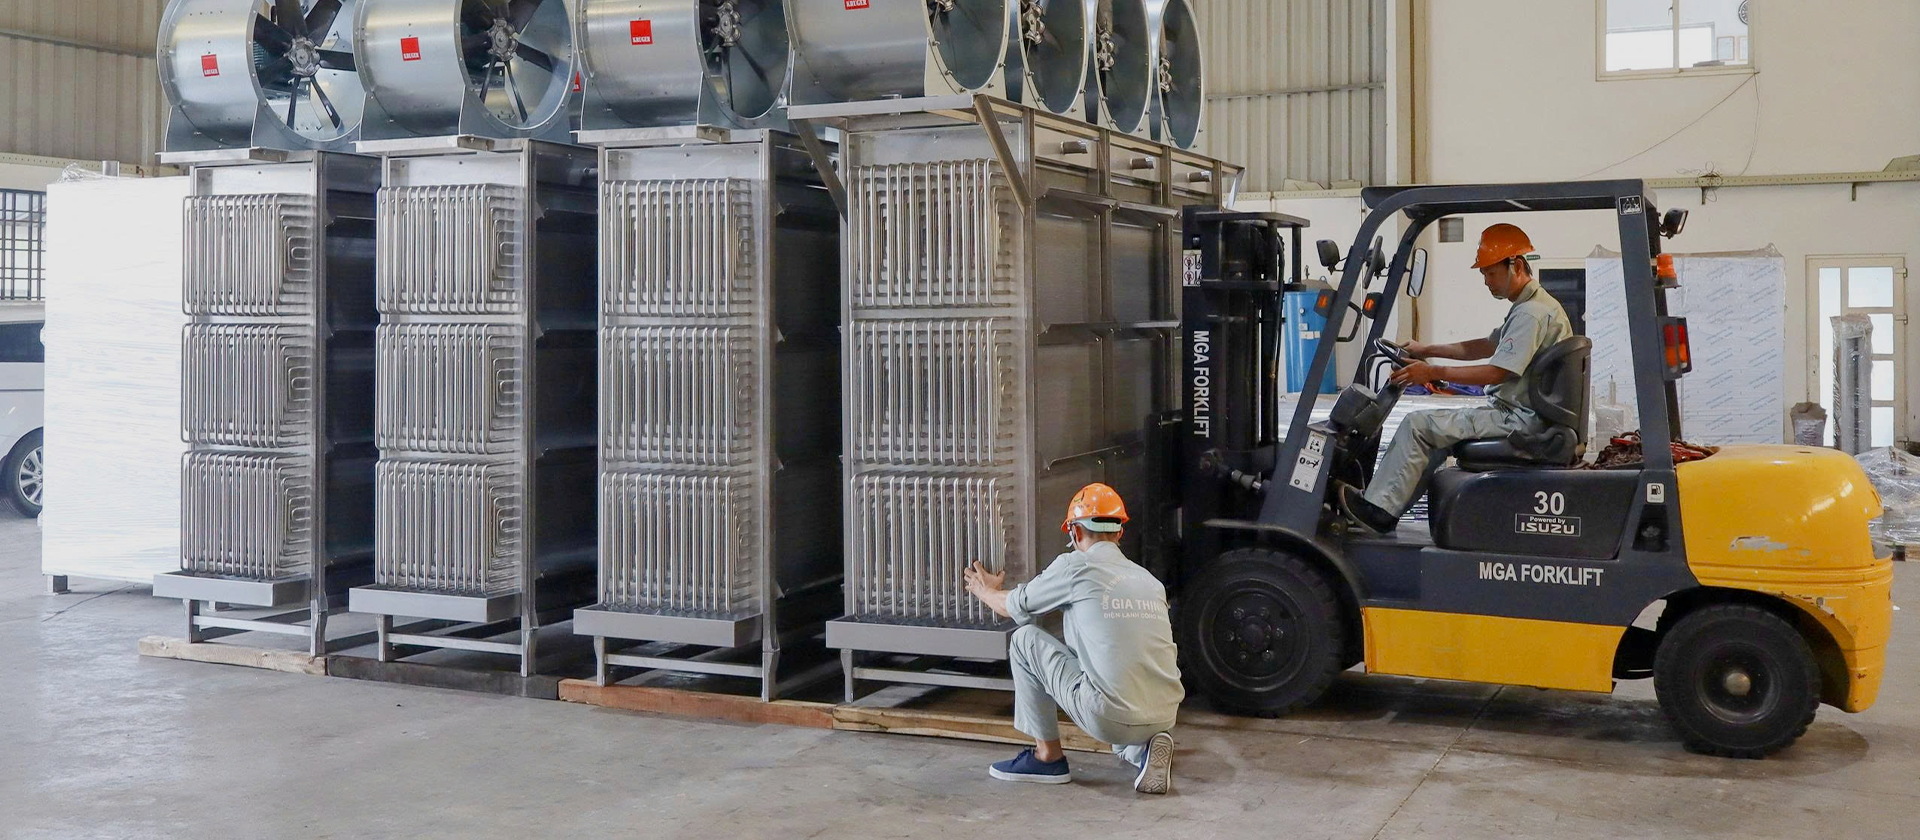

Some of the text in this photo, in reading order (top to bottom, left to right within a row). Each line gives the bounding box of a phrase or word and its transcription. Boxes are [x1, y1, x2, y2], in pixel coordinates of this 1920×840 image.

[1193, 330, 1210, 438] MGA FORKLIFT
[1533, 490, 1565, 515] 30
[1520, 522, 1575, 534] ISUZU
[1529, 516, 1566, 525] Powered by
[1479, 561, 1604, 587] MGA FORKLIFT
[1111, 598, 1133, 610] GIA
